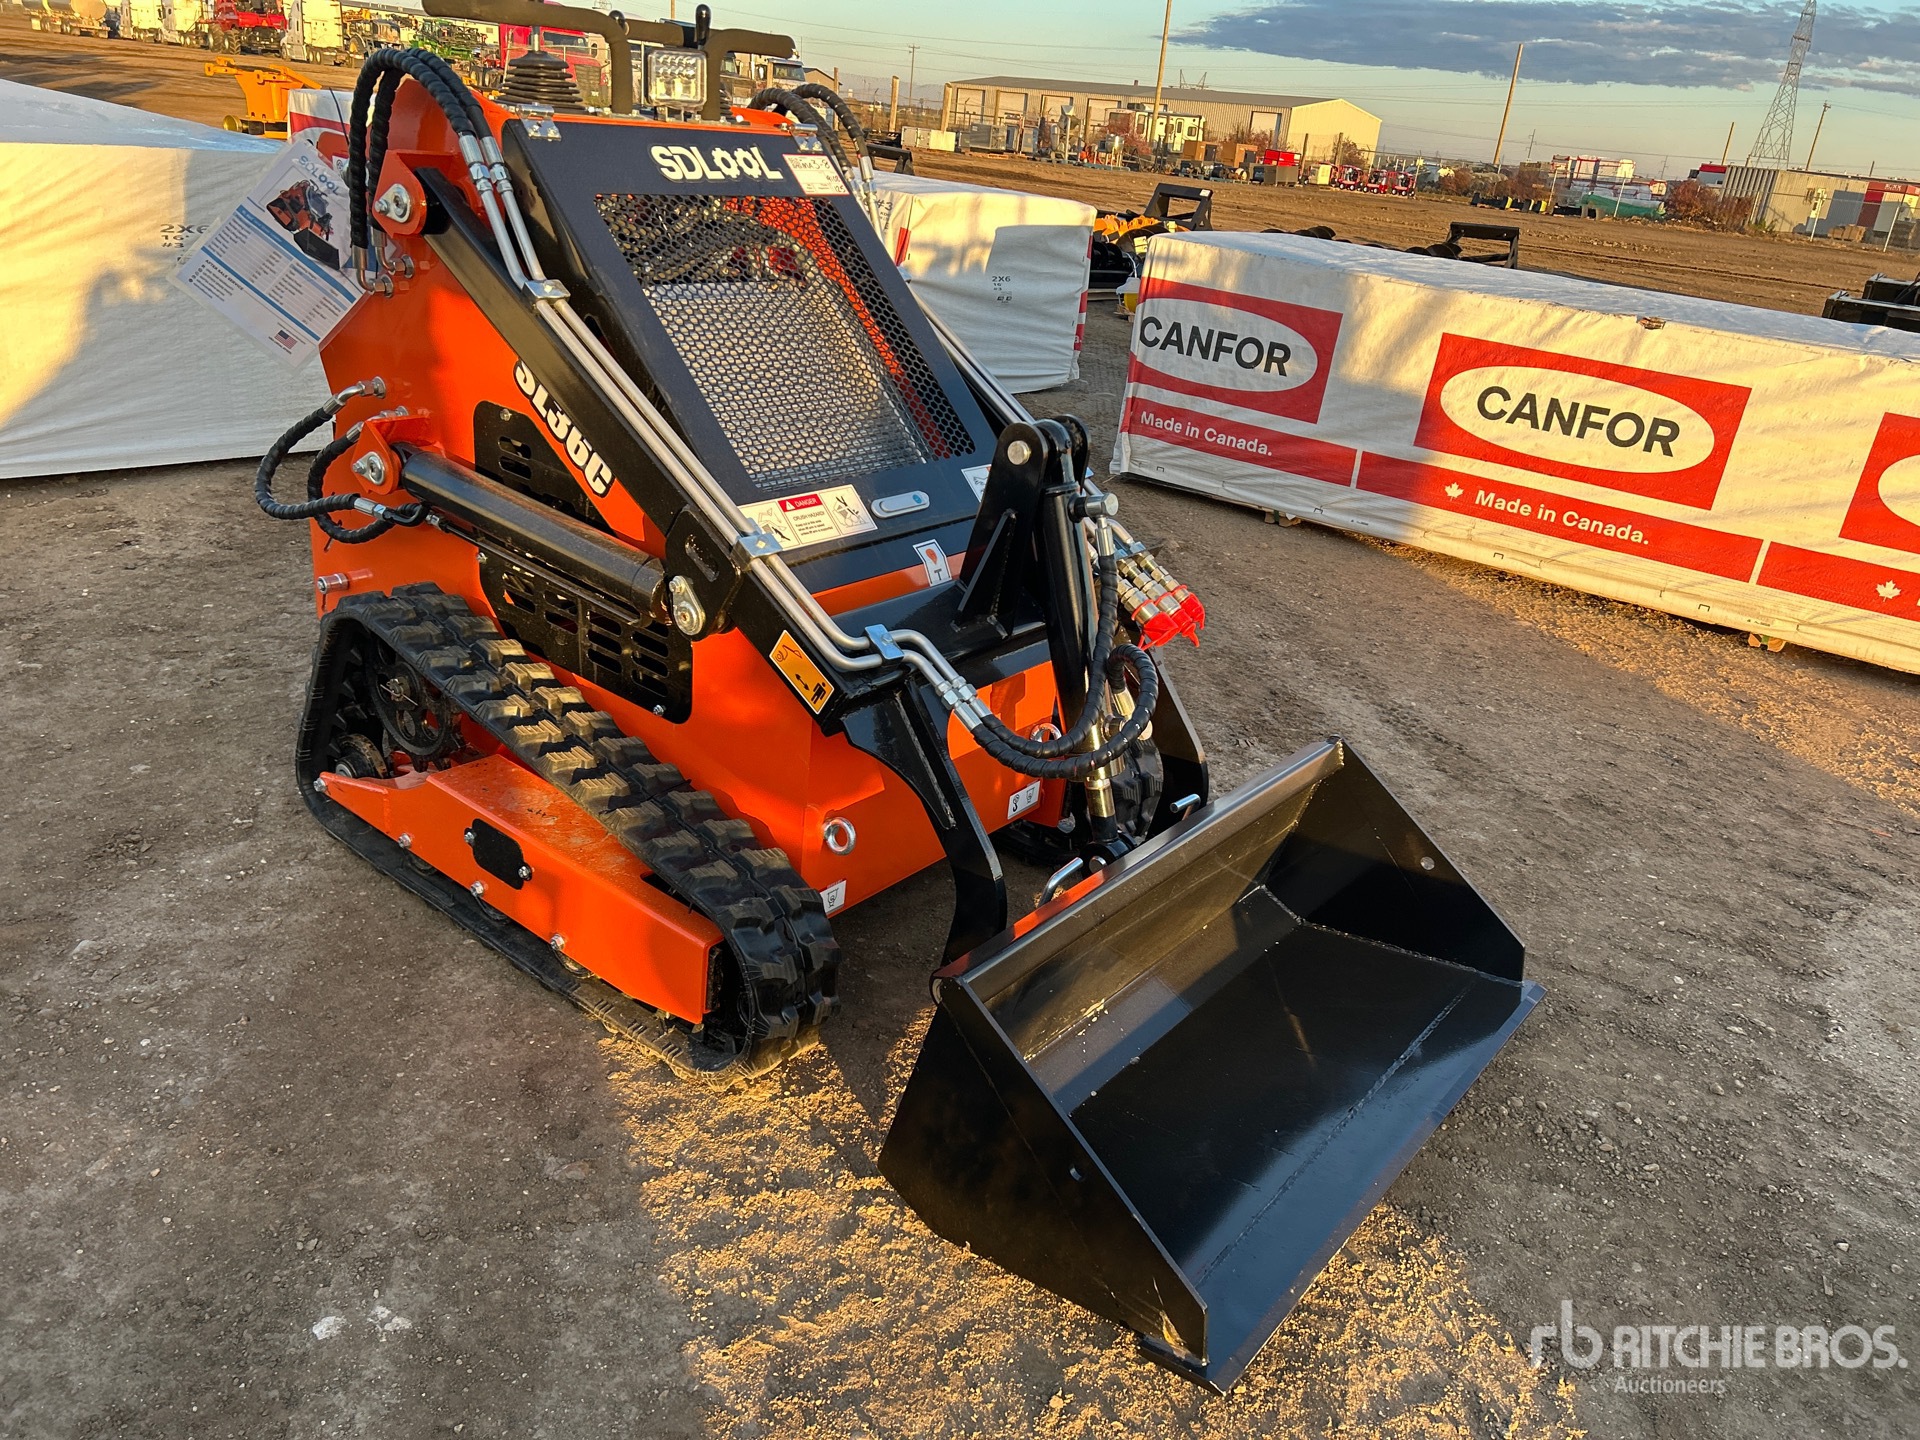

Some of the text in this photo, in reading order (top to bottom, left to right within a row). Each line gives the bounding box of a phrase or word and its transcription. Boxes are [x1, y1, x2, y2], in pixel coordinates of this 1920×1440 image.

[1139, 316, 1291, 377] CANFOR
[514, 360, 613, 495] SL36C
[1140, 411, 1273, 456] Made in Canada.
[1477, 385, 1681, 458] CANFOR
[794, 497, 818, 508] DANGER
[1474, 489, 1650, 545] Made in Canada.
